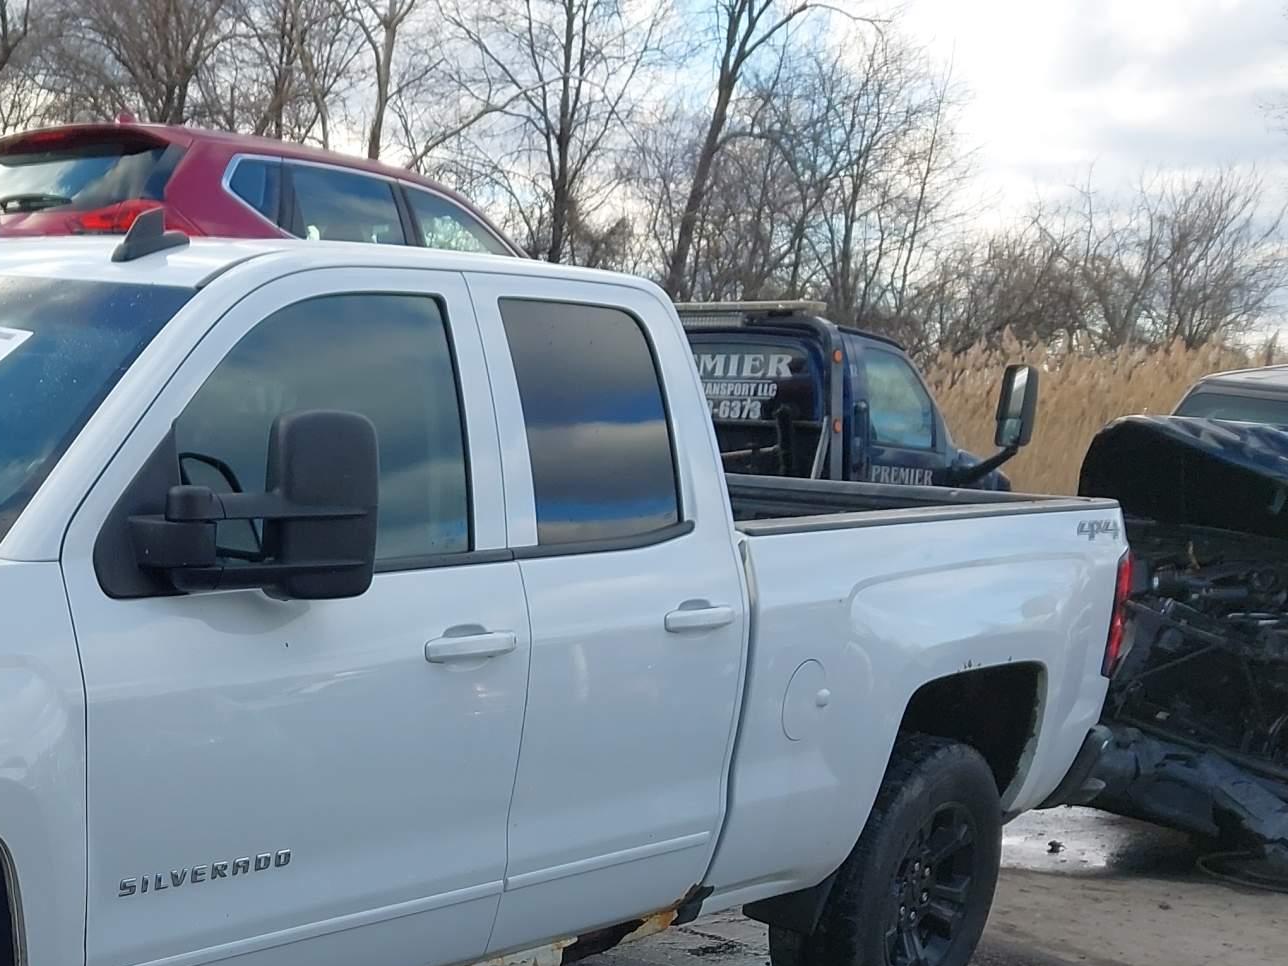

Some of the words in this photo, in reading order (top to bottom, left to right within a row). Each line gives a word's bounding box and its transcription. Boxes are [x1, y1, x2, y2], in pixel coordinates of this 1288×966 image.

[695, 353, 793, 377] MIER
[757, 383, 778, 397] LLC
[871, 465, 933, 486] PREMIER
[118, 848, 292, 897] SILVERADO
